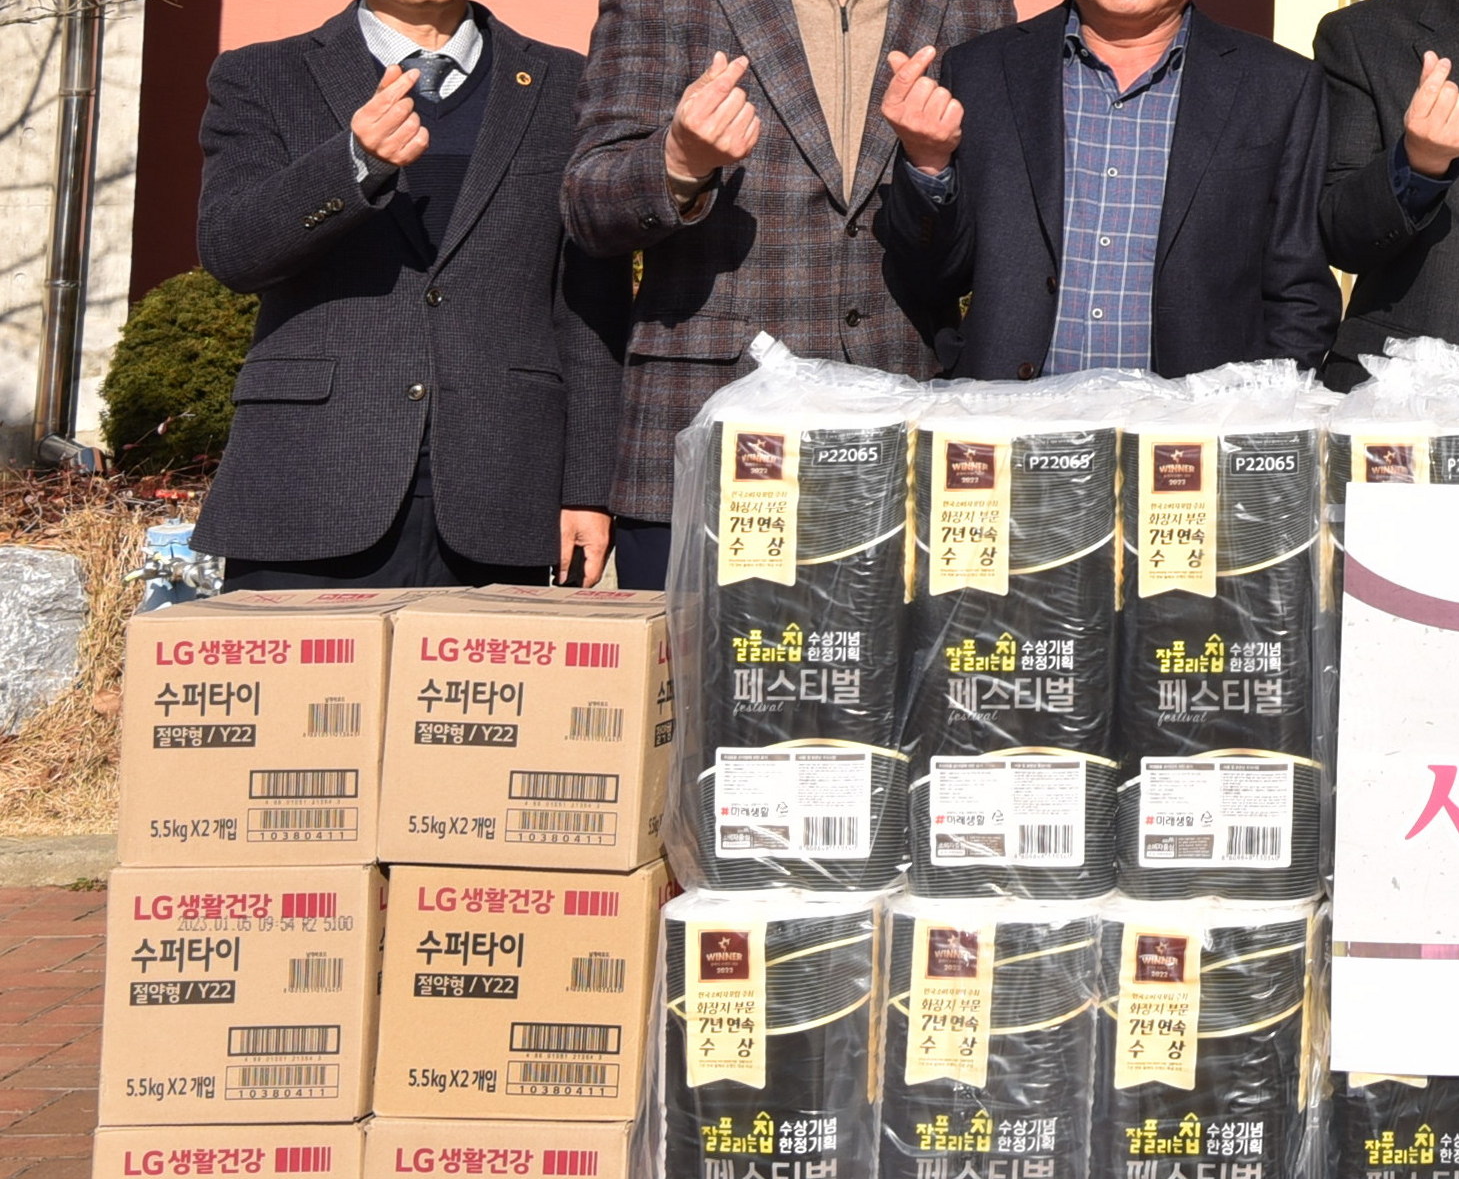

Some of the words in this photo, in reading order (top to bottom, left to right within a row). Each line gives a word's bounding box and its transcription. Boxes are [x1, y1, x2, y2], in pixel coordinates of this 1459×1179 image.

[818, 447, 878, 463] P22065
[1236, 456, 1295, 471] P22065
[1150, 529, 1173, 545] 7년
[808, 631, 860, 646] 수상기념
[156, 641, 194, 665] LG
[198, 640, 291, 665] 생활건강
[421, 637, 459, 662] LG
[463, 639, 556, 665] 생활건강
[417, 679, 524, 716] 수퍼타이
[733, 669, 860, 704] 페스티벌
[1158, 679, 1282, 714] 페스티벌
[154, 682, 260, 717] 수퍼타이
[156, 727, 203, 747] 절약형
[220, 727, 252, 742] Y22
[418, 723, 464, 744] 절약형
[482, 726, 514, 742] Y22
[150, 820, 187, 842] 5.5kg
[191, 820, 210, 836] X2
[213, 818, 237, 840] 개입
[260, 832, 344, 840] 10380411
[134, 896, 173, 920] LG
[177, 893, 272, 920] 생활건강
[418, 887, 456, 912] LG
[461, 888, 555, 915] 생활건강
[131, 937, 240, 973] 수퍼타이
[417, 931, 524, 967] 수퍼타이
[133, 983, 181, 1004] 절약형
[200, 983, 231, 998] Y22
[417, 977, 465, 996] 절약형
[481, 978, 515, 994] Y22
[409, 1069, 447, 1092] 5.5kg
[450, 1070, 469, 1087] X2
[472, 1071, 497, 1092] 개입
